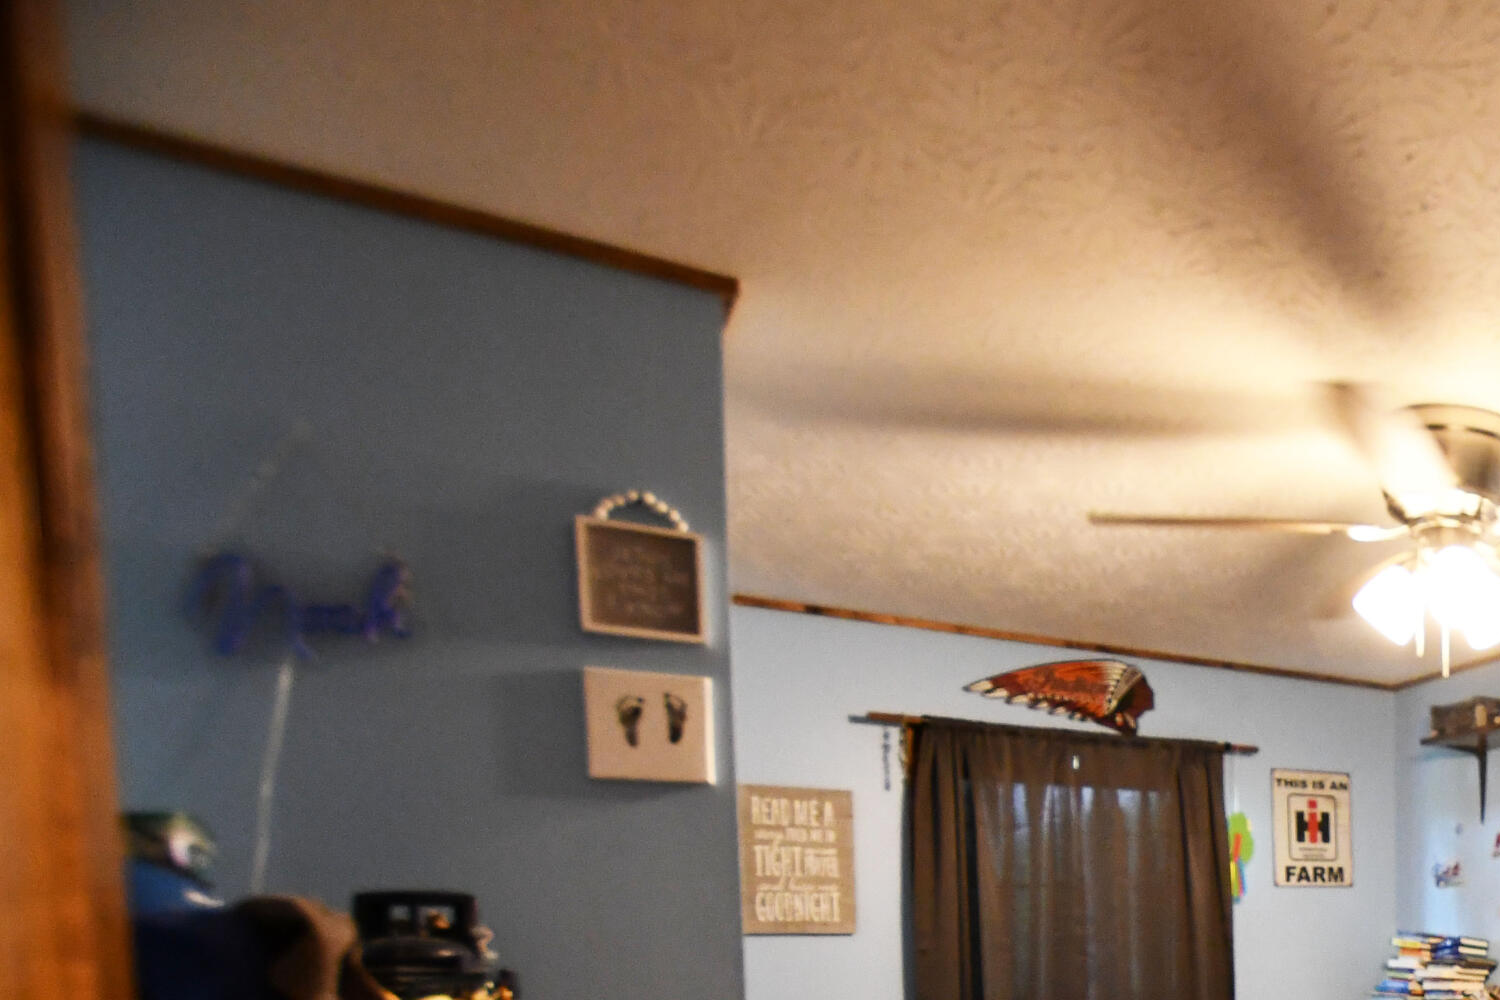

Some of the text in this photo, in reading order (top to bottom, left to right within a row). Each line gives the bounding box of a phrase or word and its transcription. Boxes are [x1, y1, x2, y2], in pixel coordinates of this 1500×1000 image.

[1275, 778, 1348, 791] THIS IS AN
[751, 795, 836, 827] READ ME A
[754, 844, 804, 877] TIGHT
[1284, 865, 1345, 883] FARM
[755, 891, 842, 923] GOODNIGHT
